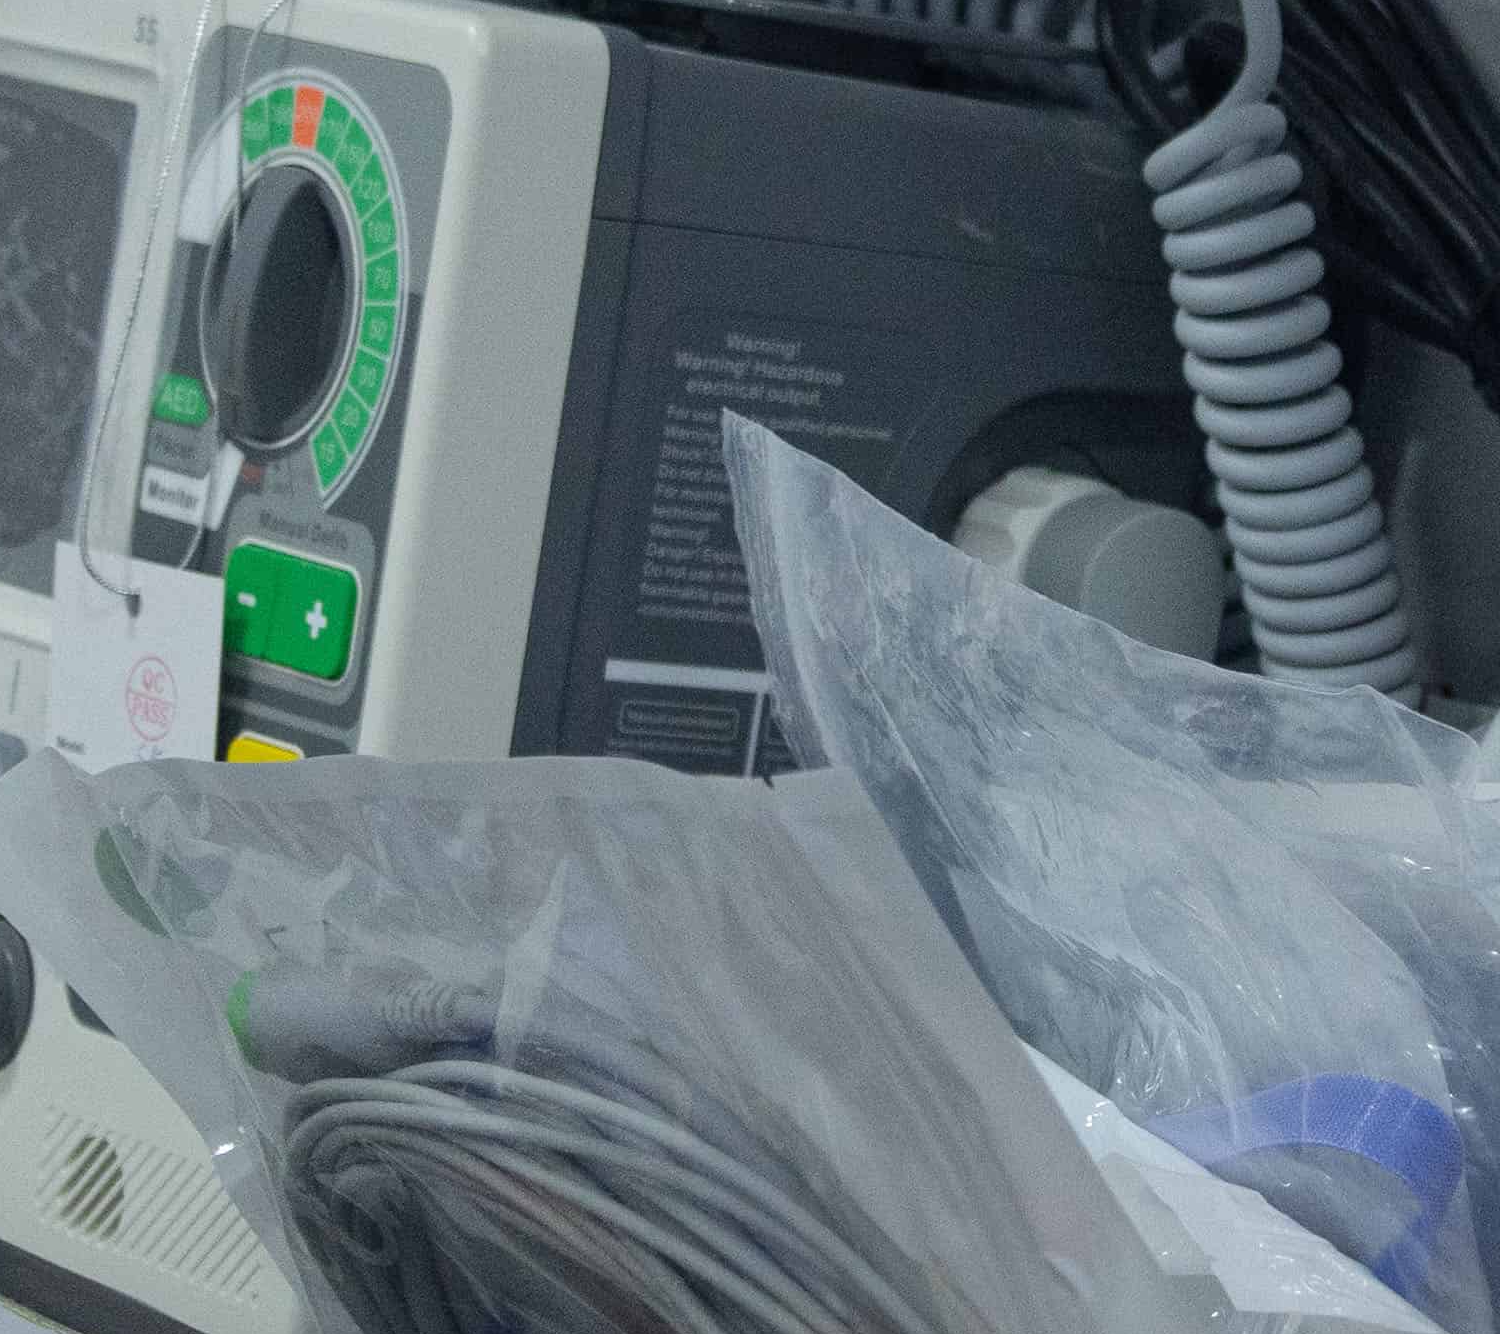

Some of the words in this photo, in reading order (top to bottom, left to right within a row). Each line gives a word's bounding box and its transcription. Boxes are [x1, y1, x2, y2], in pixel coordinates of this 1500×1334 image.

[358, 178, 383, 202] 120
[373, 268, 391, 292] 70
[754, 361, 846, 388] Hazardous
[159, 387, 200, 416] AED
[148, 479, 200, 512] Monitor
[141, 667, 167, 694] QC
[132, 694, 169, 727] PASS
